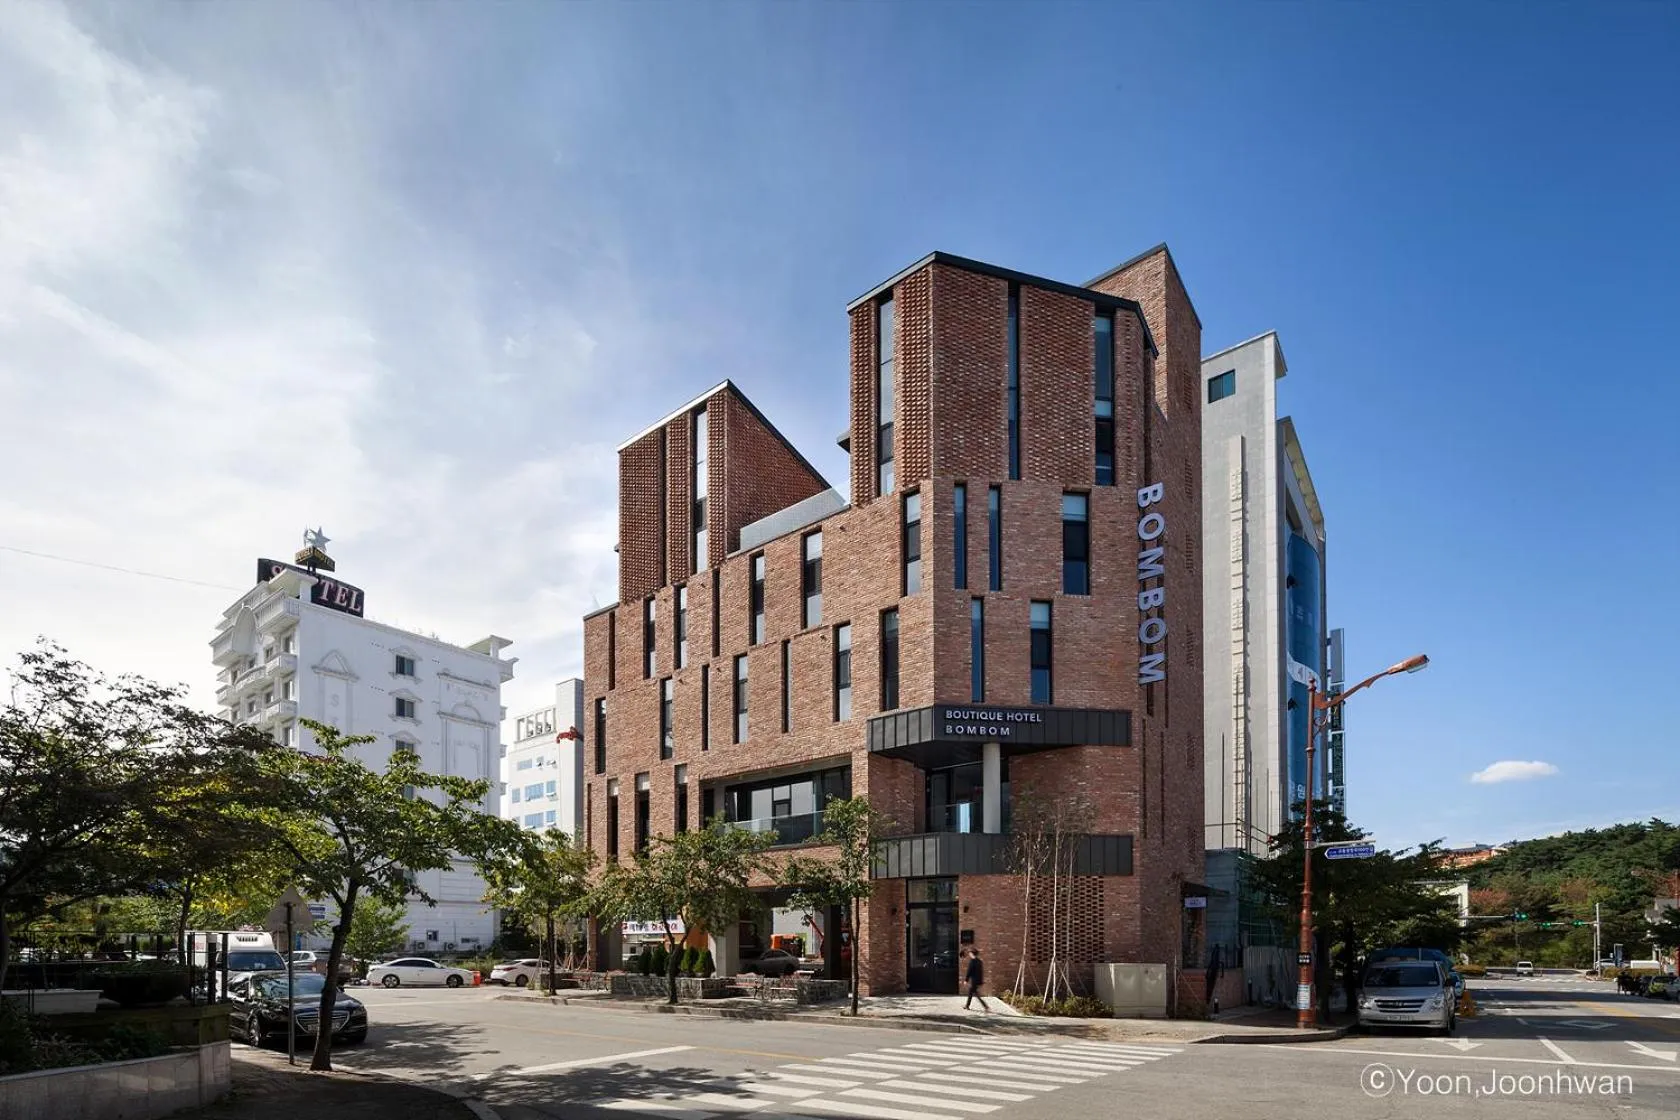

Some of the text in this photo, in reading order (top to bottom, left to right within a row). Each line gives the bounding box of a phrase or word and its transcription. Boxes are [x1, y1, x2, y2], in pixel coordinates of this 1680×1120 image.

[1137, 482, 1167, 685] BOMBOM
[945, 710, 1042, 722] BOUTIQUE HOTEL
[945, 725, 1010, 736] BOMBOM
